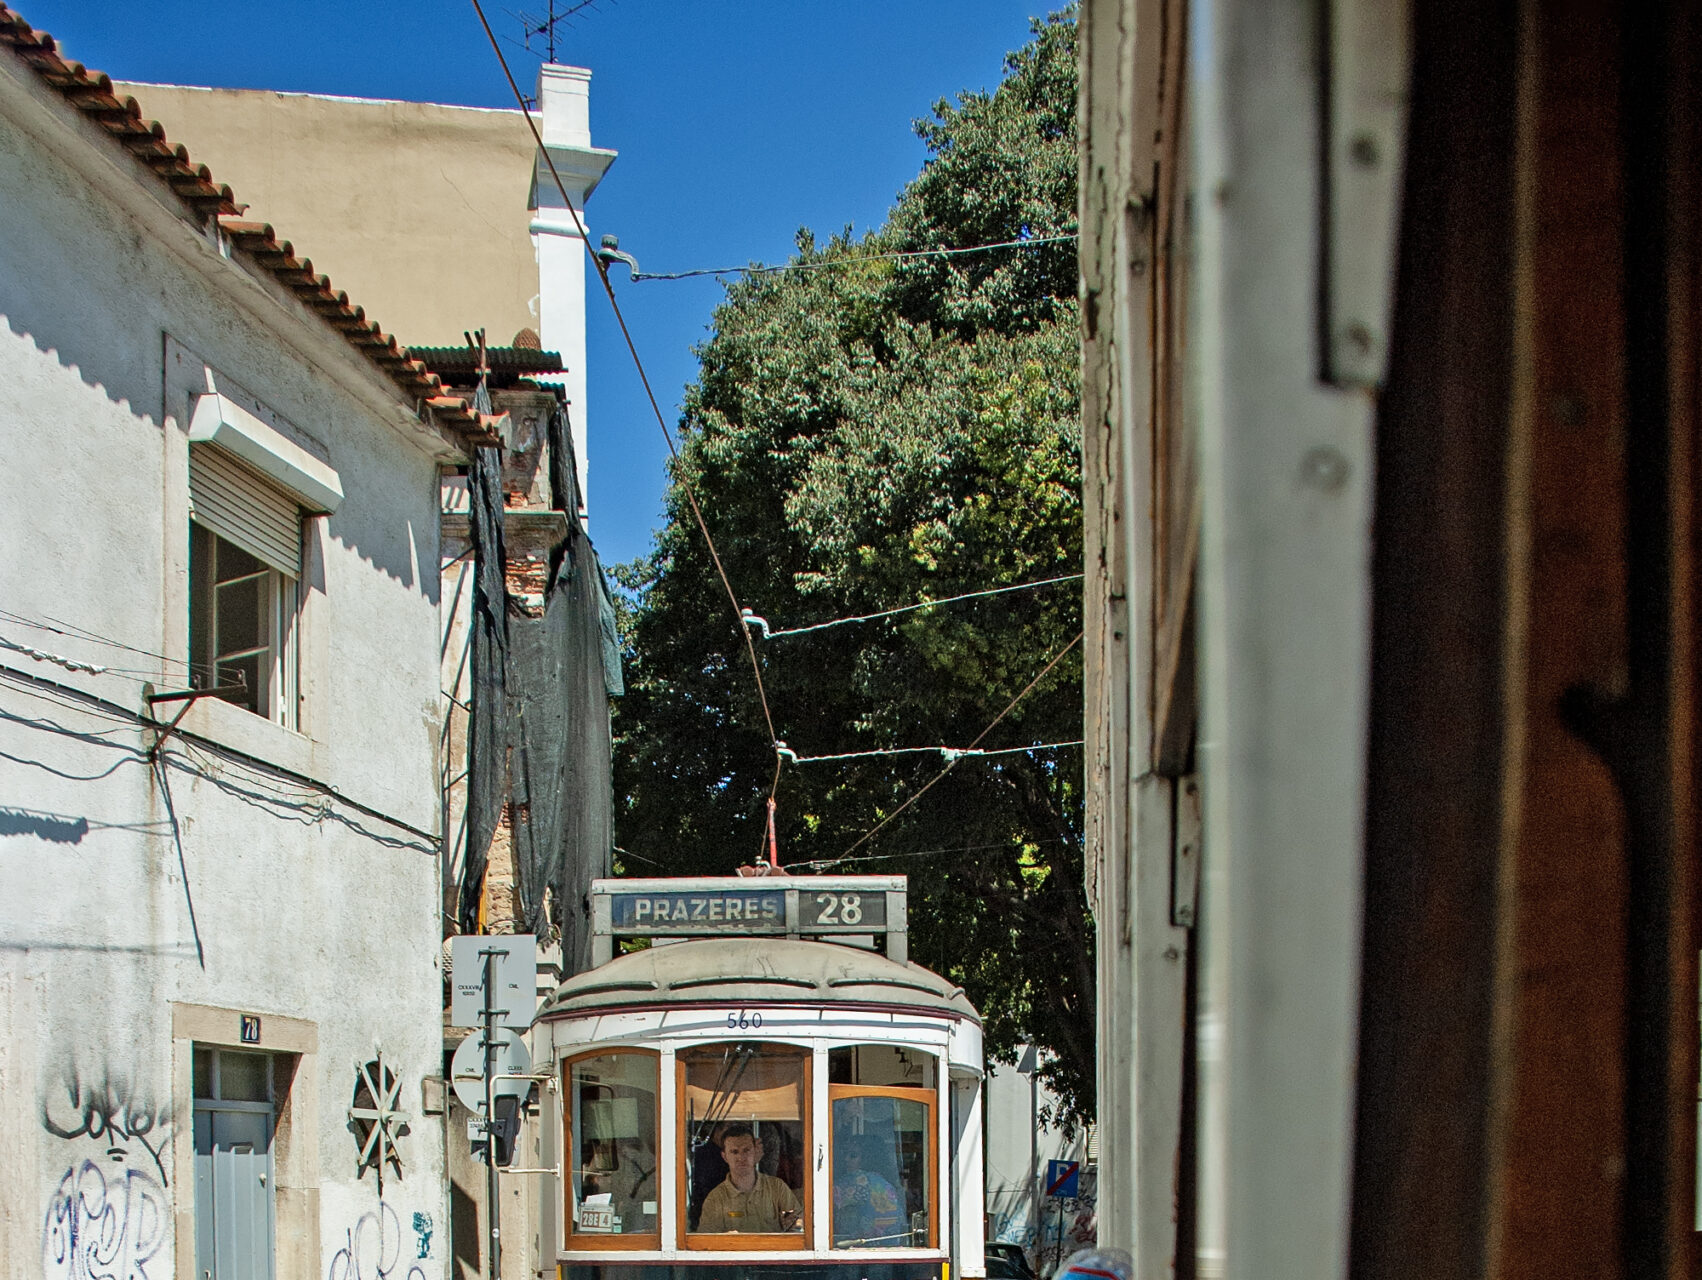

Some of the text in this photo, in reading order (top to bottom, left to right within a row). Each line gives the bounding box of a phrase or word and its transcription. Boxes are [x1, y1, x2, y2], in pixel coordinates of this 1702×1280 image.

[634, 897, 778, 921] PRAZERES
[816, 893, 863, 924] 28
[244, 1017, 258, 1040] 78
[727, 1012, 763, 1029] 560
[582, 1212, 599, 1226] 28E
